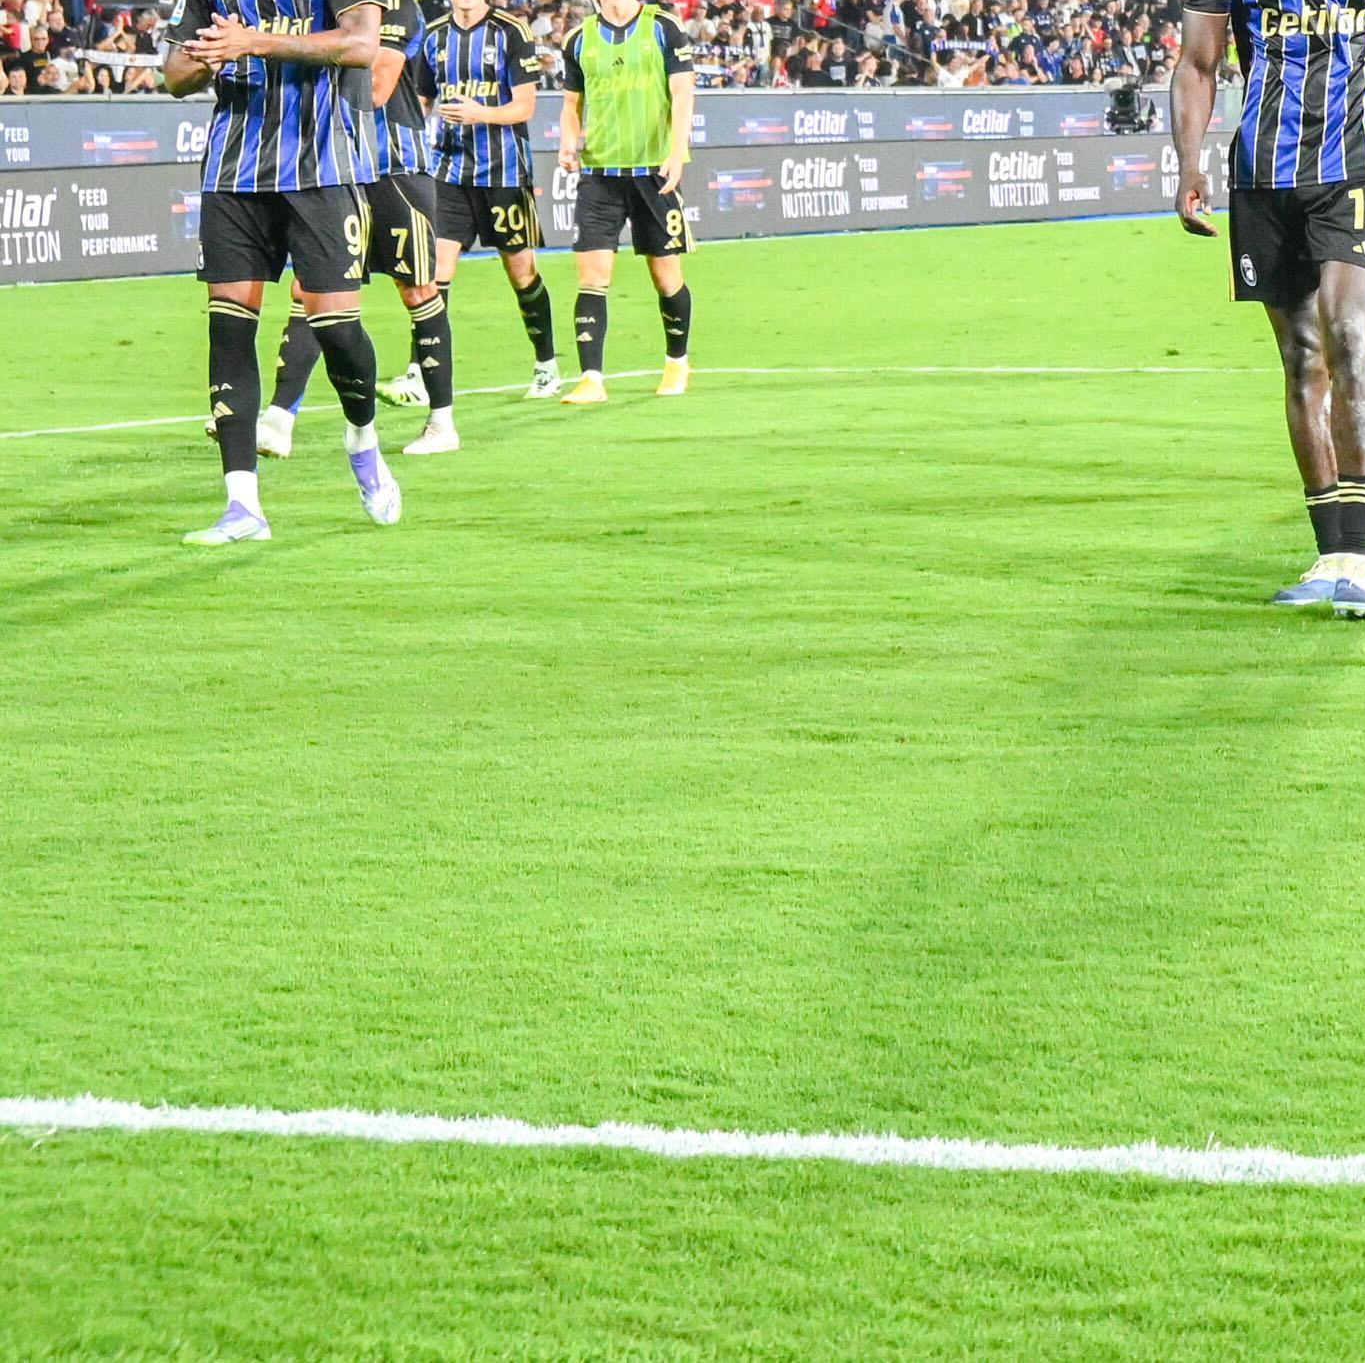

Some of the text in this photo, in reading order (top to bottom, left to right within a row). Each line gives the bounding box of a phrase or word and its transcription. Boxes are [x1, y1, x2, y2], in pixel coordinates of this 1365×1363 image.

[252, 14, 314, 35] tilar
[4, 126, 30, 143] FEED
[793, 109, 848, 136] Cetilar
[962, 109, 1011, 134] Cetilar
[5, 148, 30, 163] YOUR
[988, 151, 1047, 182] Cetilar
[780, 157, 847, 190] Cetilar
[0, 188, 58, 228] ilar
[78, 188, 108, 207] FEED
[781, 190, 850, 219] NUTRITION
[989, 183, 1050, 208] NUTRITION
[80, 212, 110, 231] YOUR
[490, 203, 525, 233] 20
[665, 209, 682, 237] 8
[0, 230, 62, 266] ITION
[81, 234, 159, 256] PERFORMANCE
[343, 214, 362, 256] 9
[390, 227, 408, 259] 7
